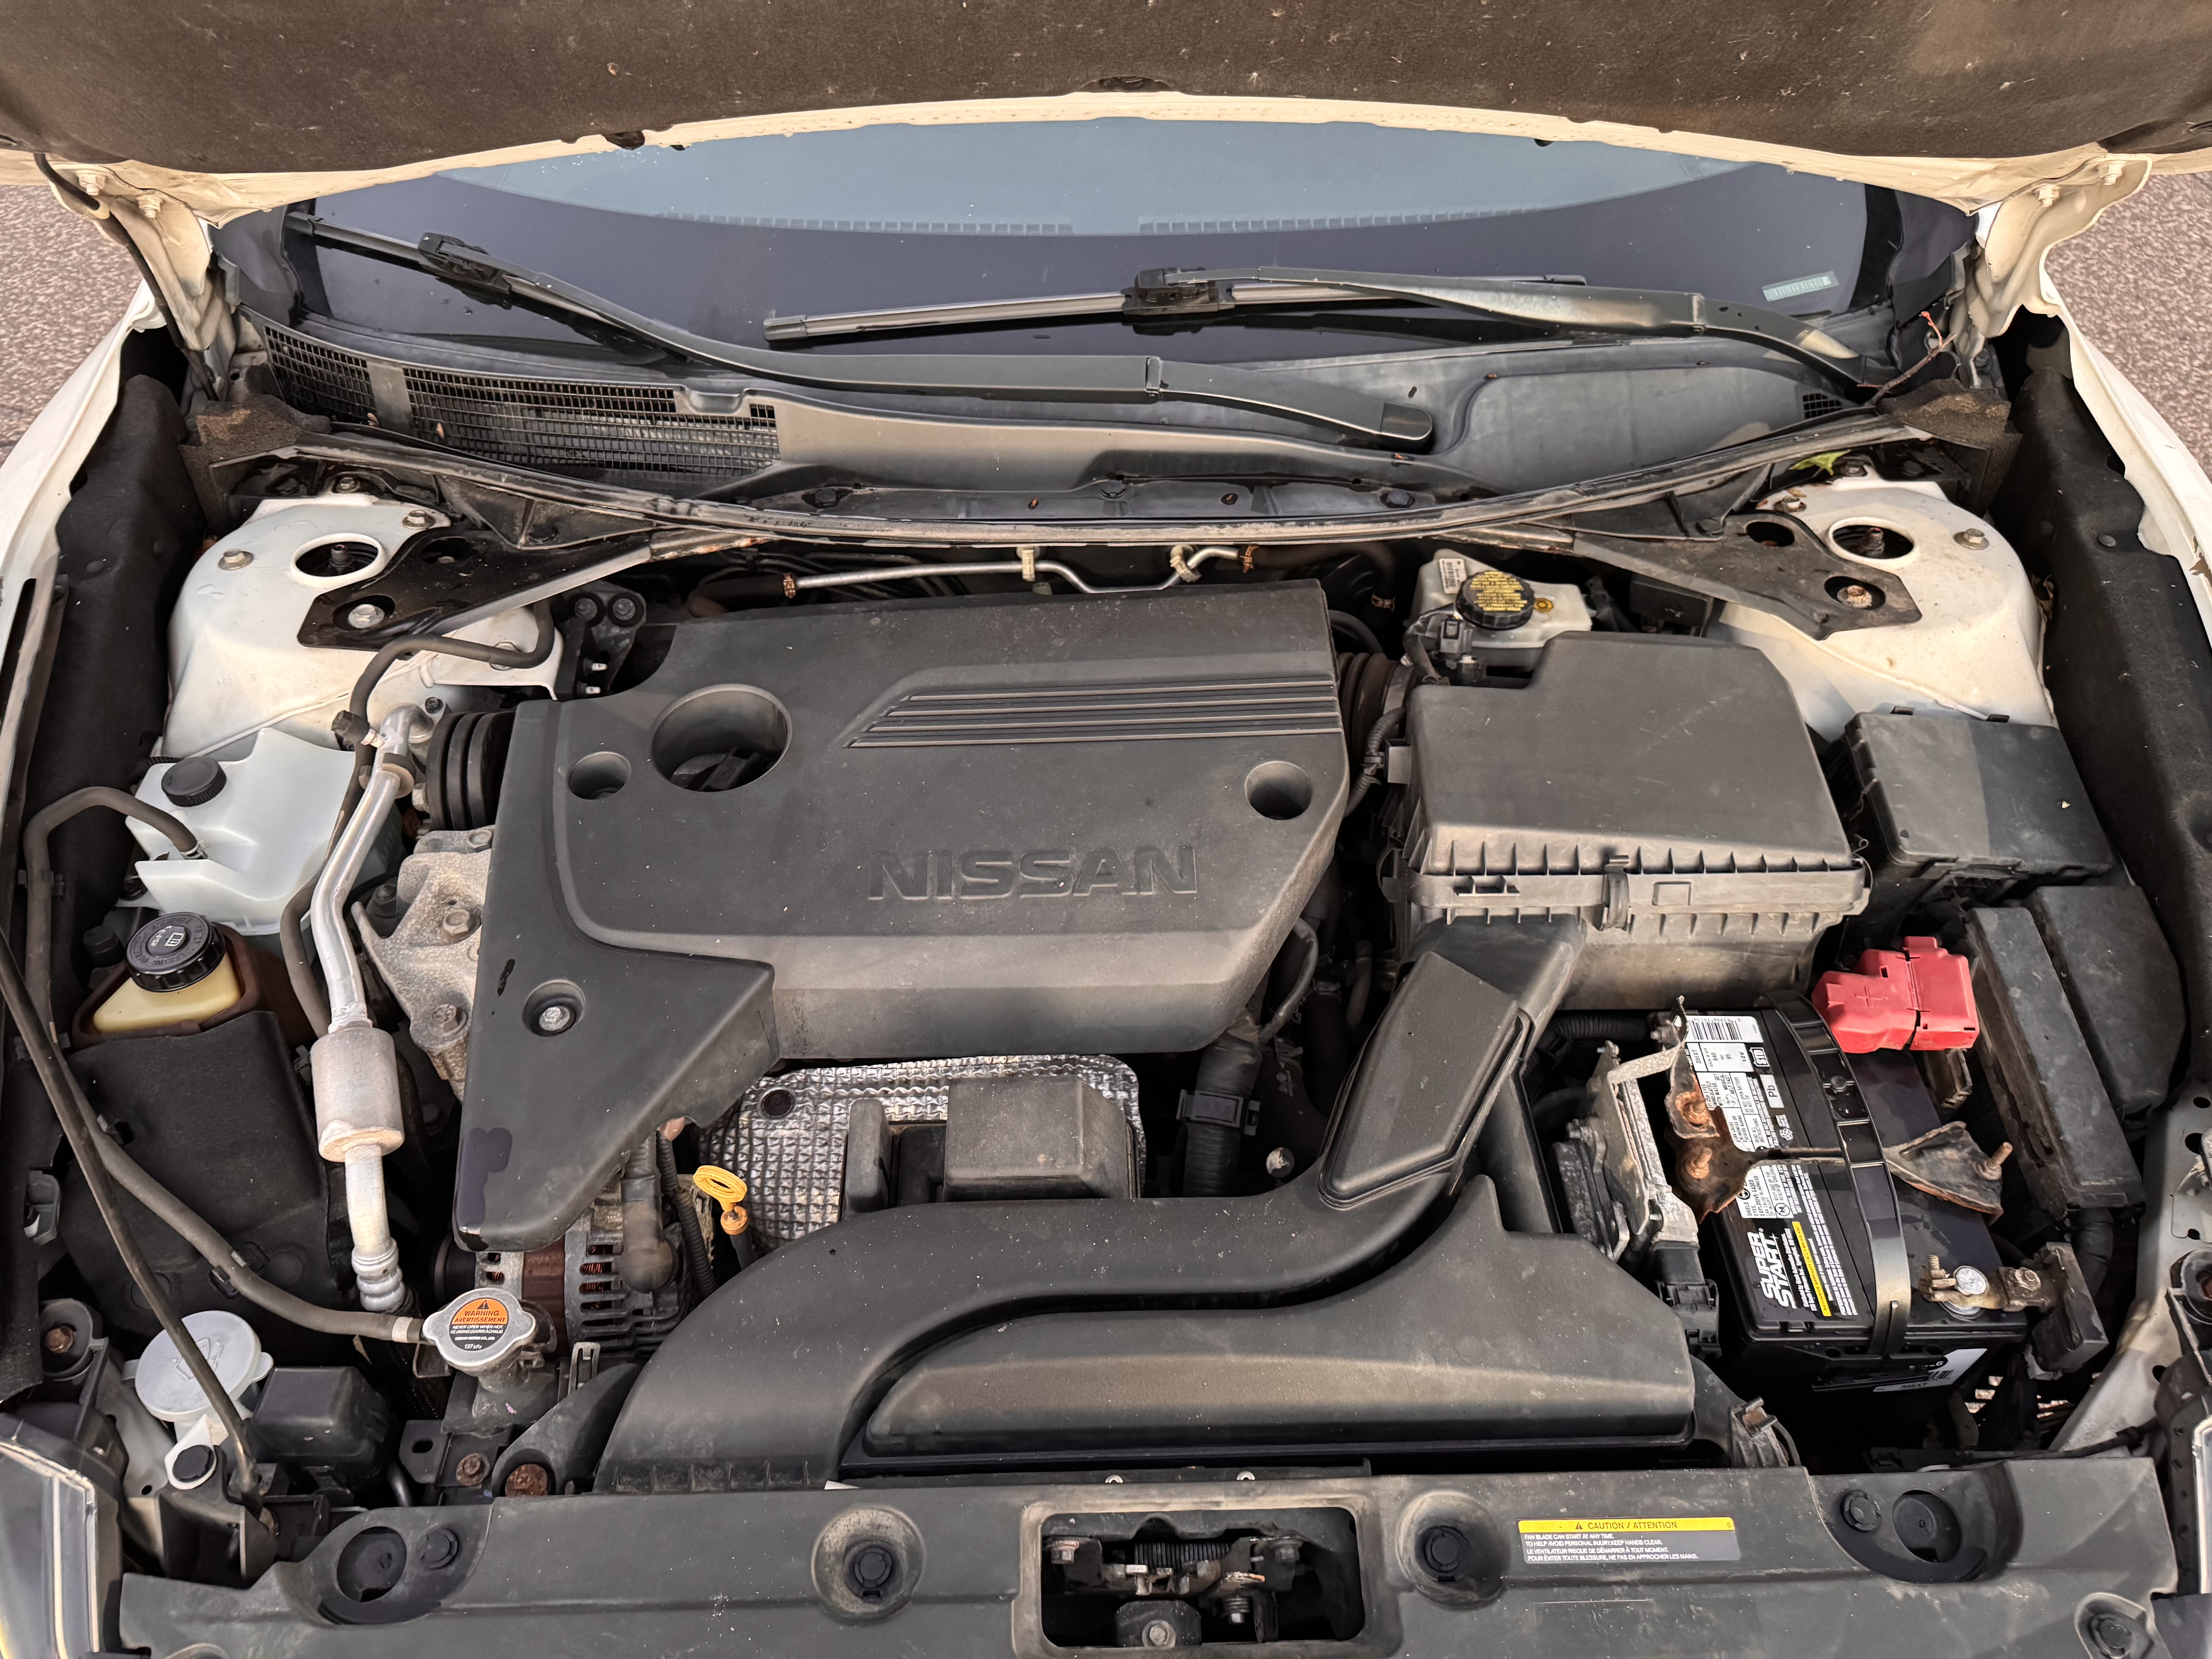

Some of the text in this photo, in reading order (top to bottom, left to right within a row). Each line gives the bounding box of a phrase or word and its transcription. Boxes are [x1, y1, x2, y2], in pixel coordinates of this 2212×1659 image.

[867, 845, 1199, 900] NISSAN
[1706, 1081, 1717, 1106] IMMEDIATELY
[1719, 1074, 1728, 1090] MEDICAL
[1766, 1085, 1777, 1096] Pb
[1744, 1202, 1752, 1216] SHIELD
[1748, 1180, 1765, 1216] EXPLOSIVE GASES
[1747, 1232, 1777, 1298] SUPER
[1759, 1232, 1797, 1309] START
